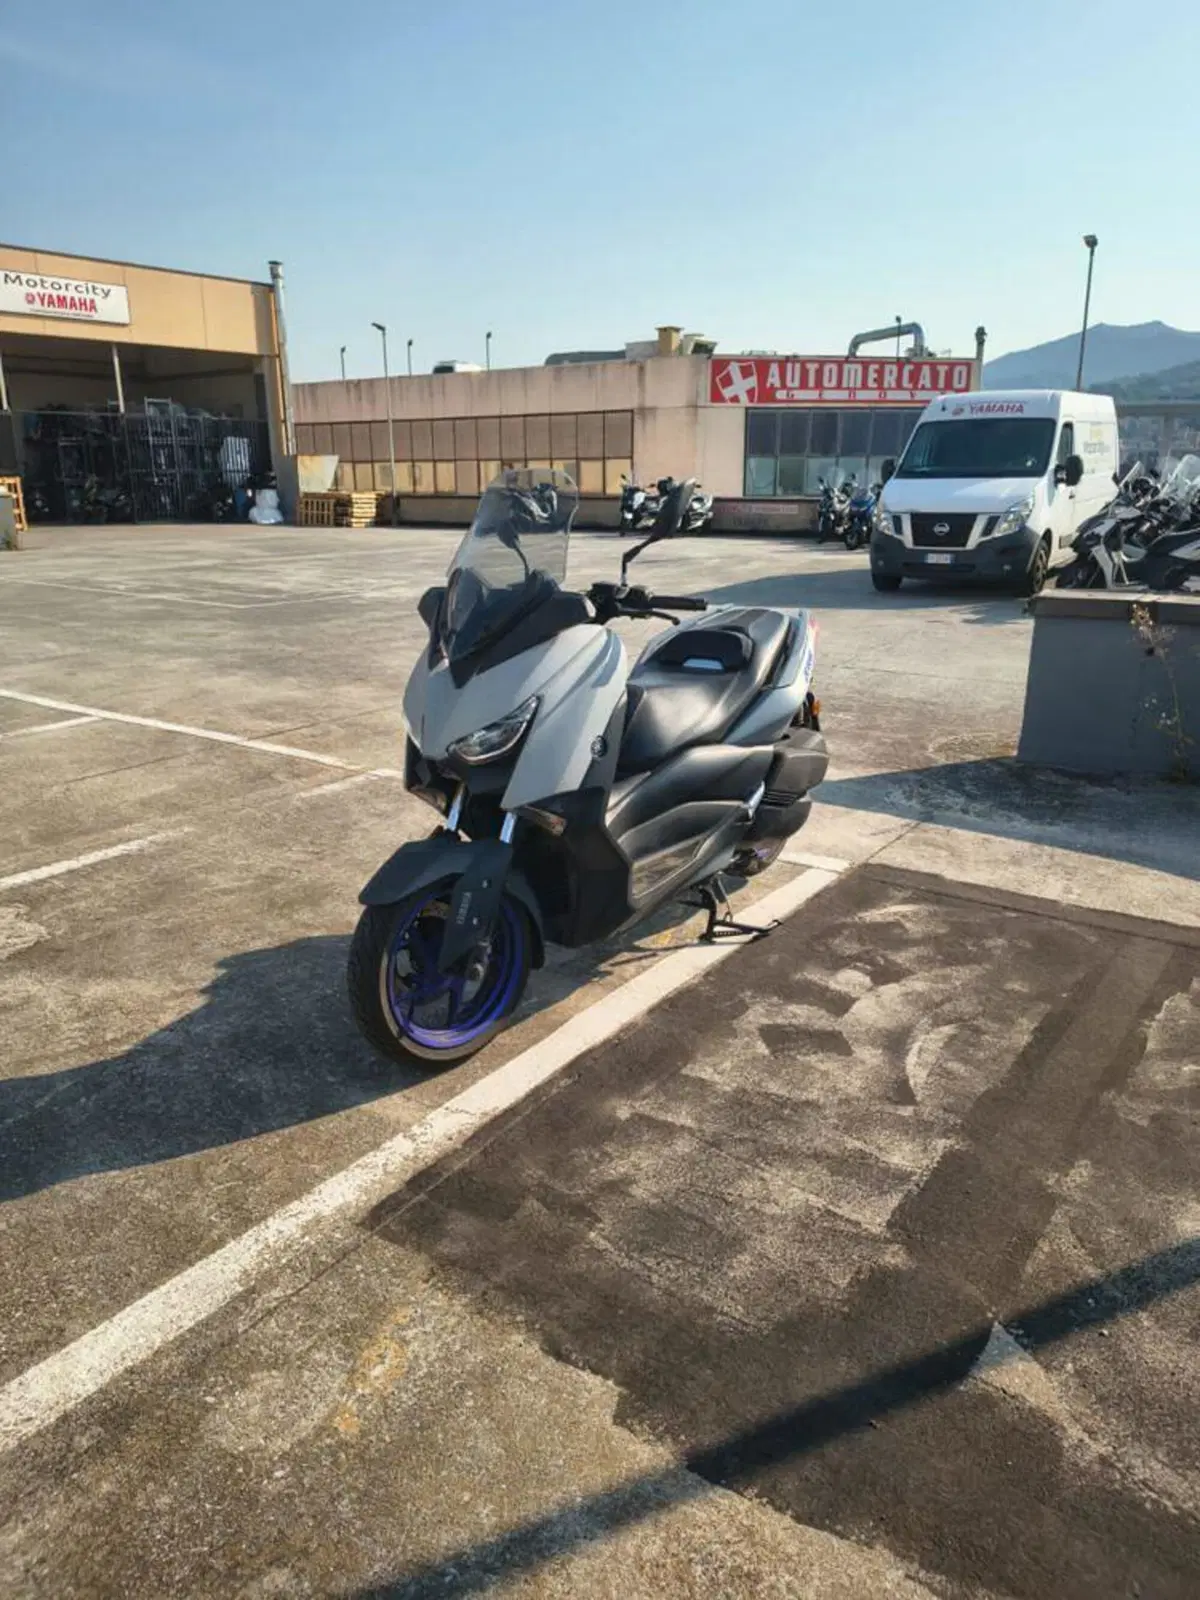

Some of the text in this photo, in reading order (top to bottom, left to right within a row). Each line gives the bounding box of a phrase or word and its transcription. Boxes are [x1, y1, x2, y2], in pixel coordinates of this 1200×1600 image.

[4, 273, 111, 299] Motorcity
[37, 291, 98, 313] YAMAHA
[766, 362, 968, 389] AUTOMERCATO
[969, 402, 1024, 414] YAMAHA
